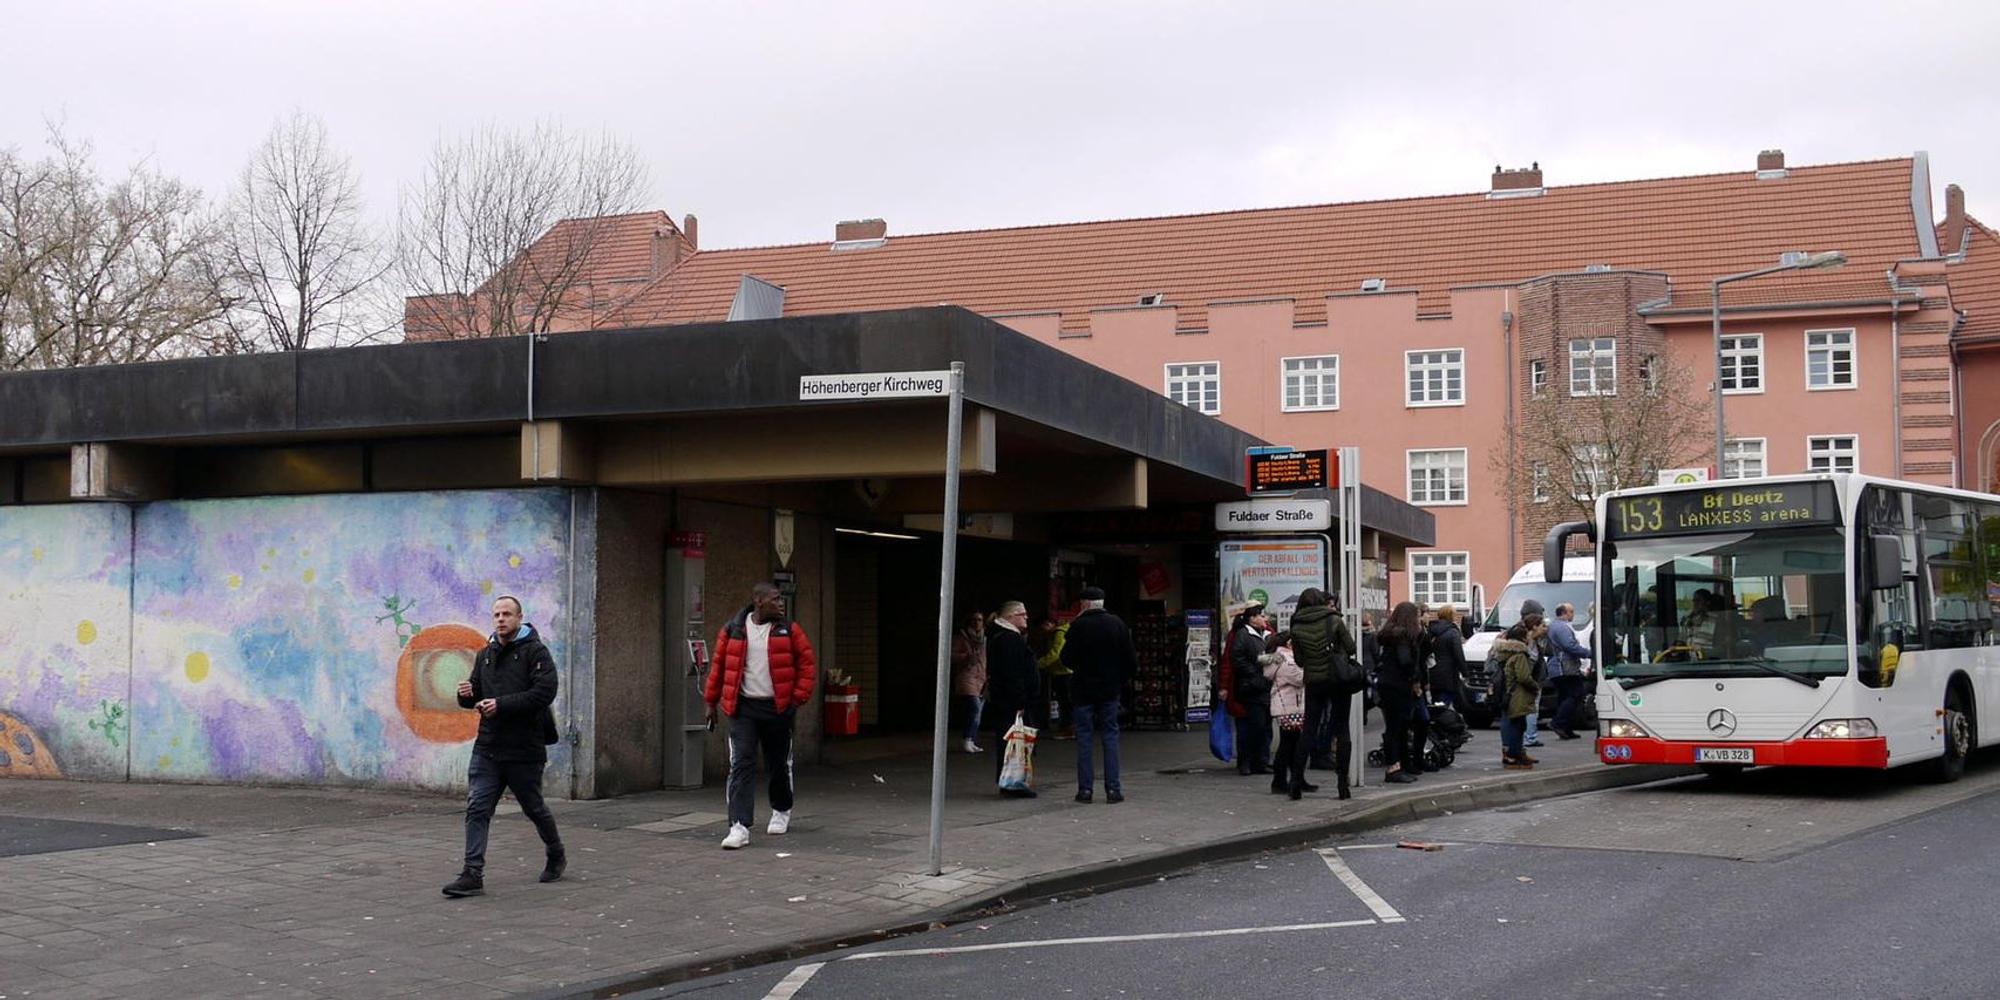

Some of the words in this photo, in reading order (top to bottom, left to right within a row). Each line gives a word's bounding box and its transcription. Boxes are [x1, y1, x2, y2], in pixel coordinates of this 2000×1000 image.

[802, 379, 881, 395] Höhenberger
[884, 376, 943, 393] Kirchweg
[1703, 494, 1725, 509] Bf
[1732, 490, 1784, 507] Deutz
[1228, 510, 1270, 522] Fuldaer
[1275, 509, 1314, 521] Straße
[1618, 498, 1663, 533] 153
[1679, 509, 1752, 528] LANXESS
[1760, 508, 1810, 522] arena
[778, 543, 791, 554] SOS
[1258, 554, 1273, 564] DER
[1302, 553, 1318, 563] UND
[1731, 750, 1750, 760] 328
